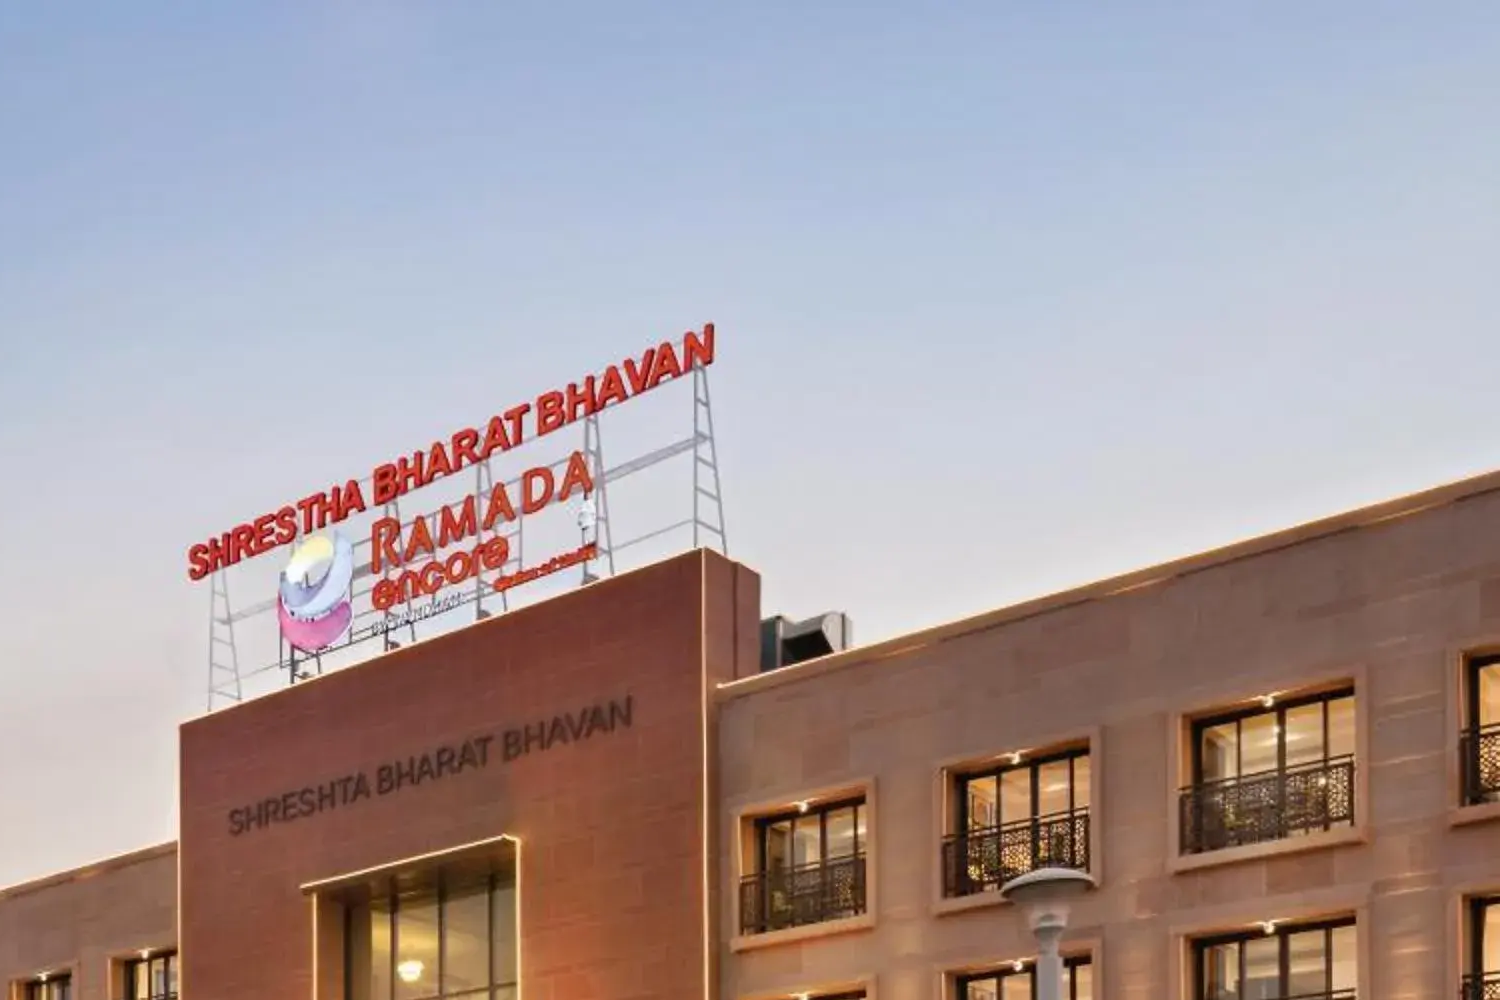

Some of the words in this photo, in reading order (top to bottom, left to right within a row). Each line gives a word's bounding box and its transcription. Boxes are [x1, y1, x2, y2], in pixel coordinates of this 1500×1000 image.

[188, 479, 366, 581] SHRESTHA
[373, 403, 530, 506] BHARAT
[537, 322, 714, 437] BHAVAN
[371, 451, 593, 574] RAMADA
[371, 536, 509, 610] encore
[228, 773, 371, 837] SHRESHTA
[375, 734, 494, 796] BHARAT
[503, 695, 634, 763] BHAVAN
